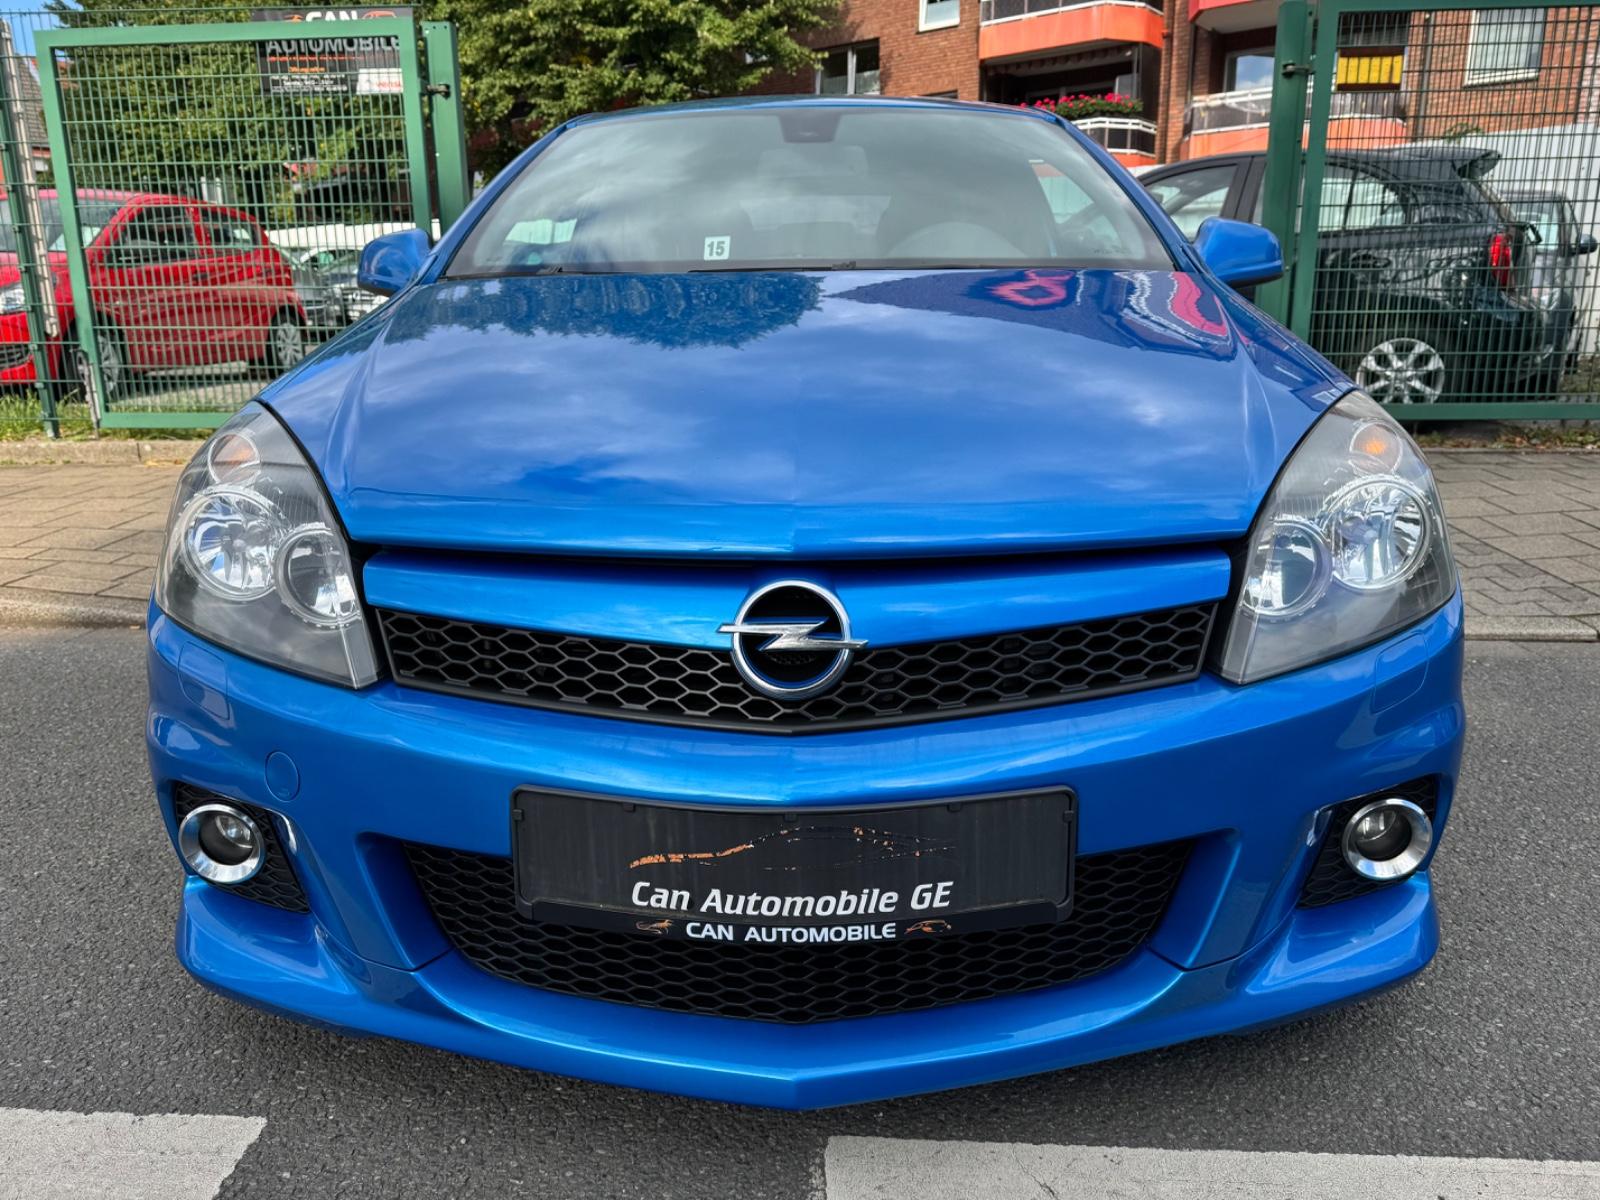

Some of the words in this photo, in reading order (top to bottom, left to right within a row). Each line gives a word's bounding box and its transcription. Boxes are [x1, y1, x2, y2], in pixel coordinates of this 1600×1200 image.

[707, 241, 725, 257] 15
[631, 881, 690, 911] Can
[700, 888, 899, 917] Automobile
[910, 881, 954, 910] GE
[686, 922, 734, 941] CAN
[744, 922, 896, 943] AUTOMOBILE
